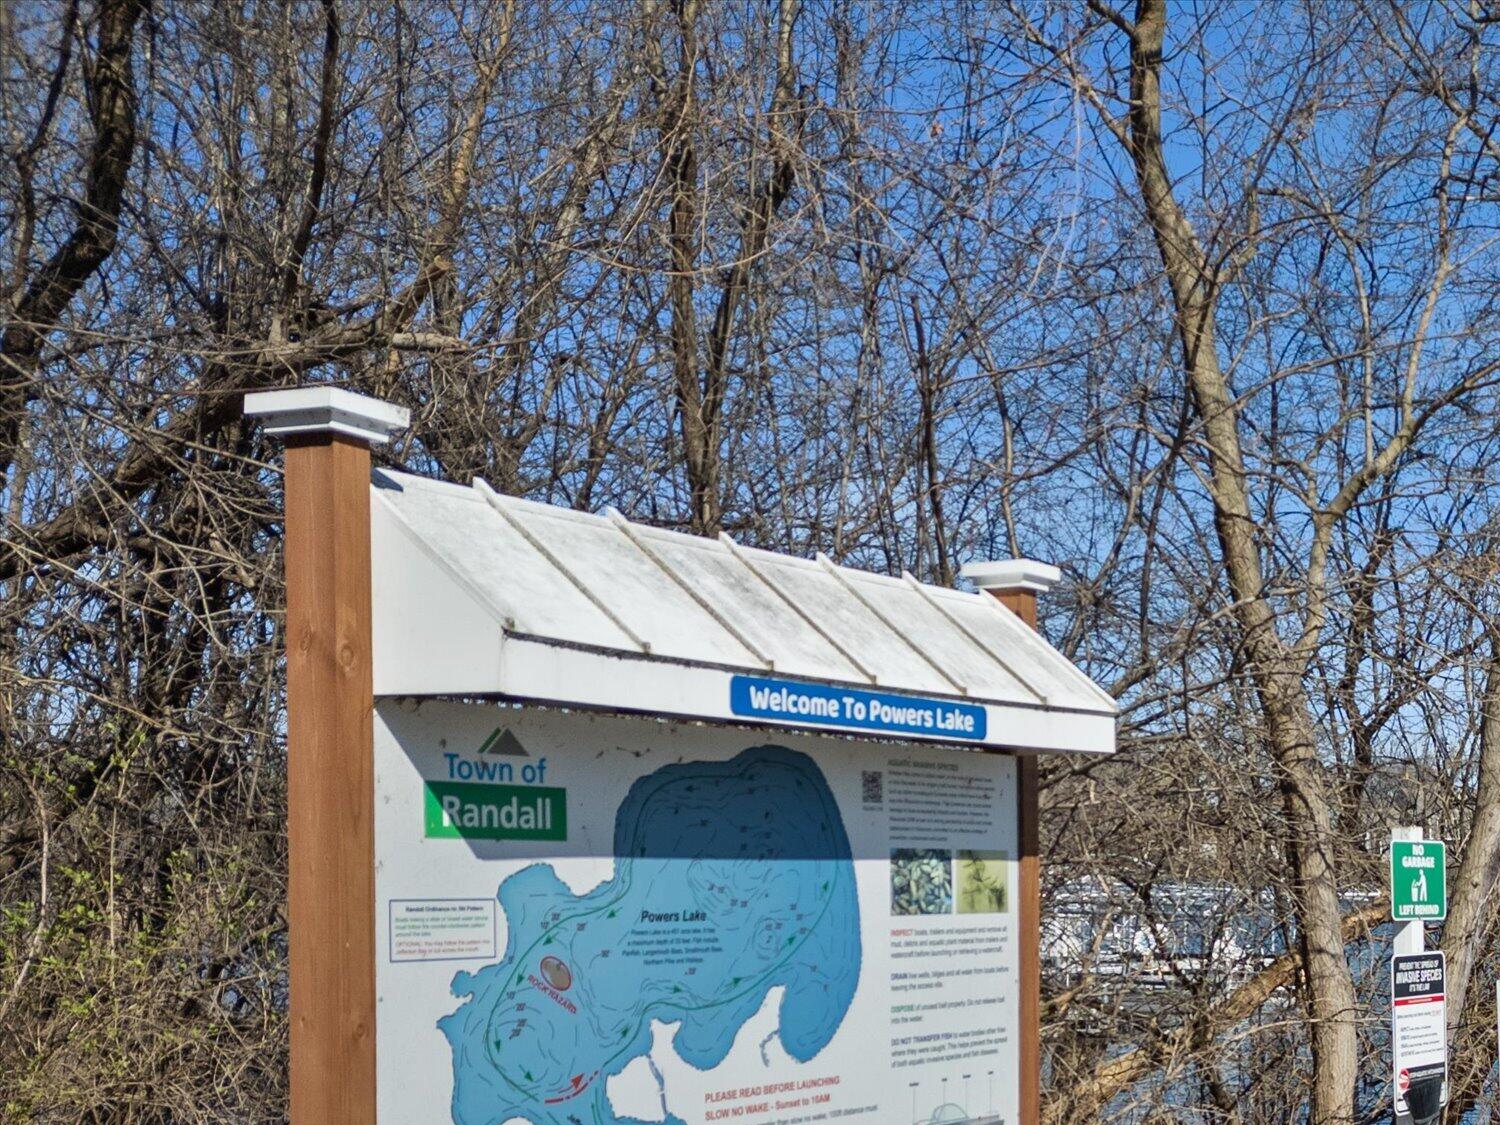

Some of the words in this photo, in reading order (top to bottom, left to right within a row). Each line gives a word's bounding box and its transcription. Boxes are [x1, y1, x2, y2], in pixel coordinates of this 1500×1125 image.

[749, 684, 840, 718] Welcome
[842, 696, 867, 720] To
[869, 700, 934, 728] Powers
[936, 707, 974, 732] Lake
[443, 752, 513, 782] Town
[521, 757, 547, 784] of
[441, 794, 551, 831] Randall
[1412, 844, 1424, 856] NO
[1401, 856, 1435, 868] GARBAGE
[640, 910, 679, 922] Powers
[682, 909, 706, 921] Lake
[1399, 904, 1414, 915] LEFT
[1415, 904, 1439, 915] BEHIND
[1395, 970, 1420, 984] INVASIVE
[1420, 968, 1442, 982] SPECIES
[527, 974, 549, 993] ROCK
[547, 988, 577, 1015] HAZARD
[704, 1089, 737, 1102] PLEASE
[738, 1086, 761, 1097] READ
[762, 1081, 795, 1095] BEFORE
[796, 1075, 839, 1089] LAUNCHING
[705, 1108, 730, 1121] SLOW
[731, 1105, 743, 1116] NO
[744, 1102, 768, 1114] WAKE
[775, 1098, 800, 1110] Sunset
